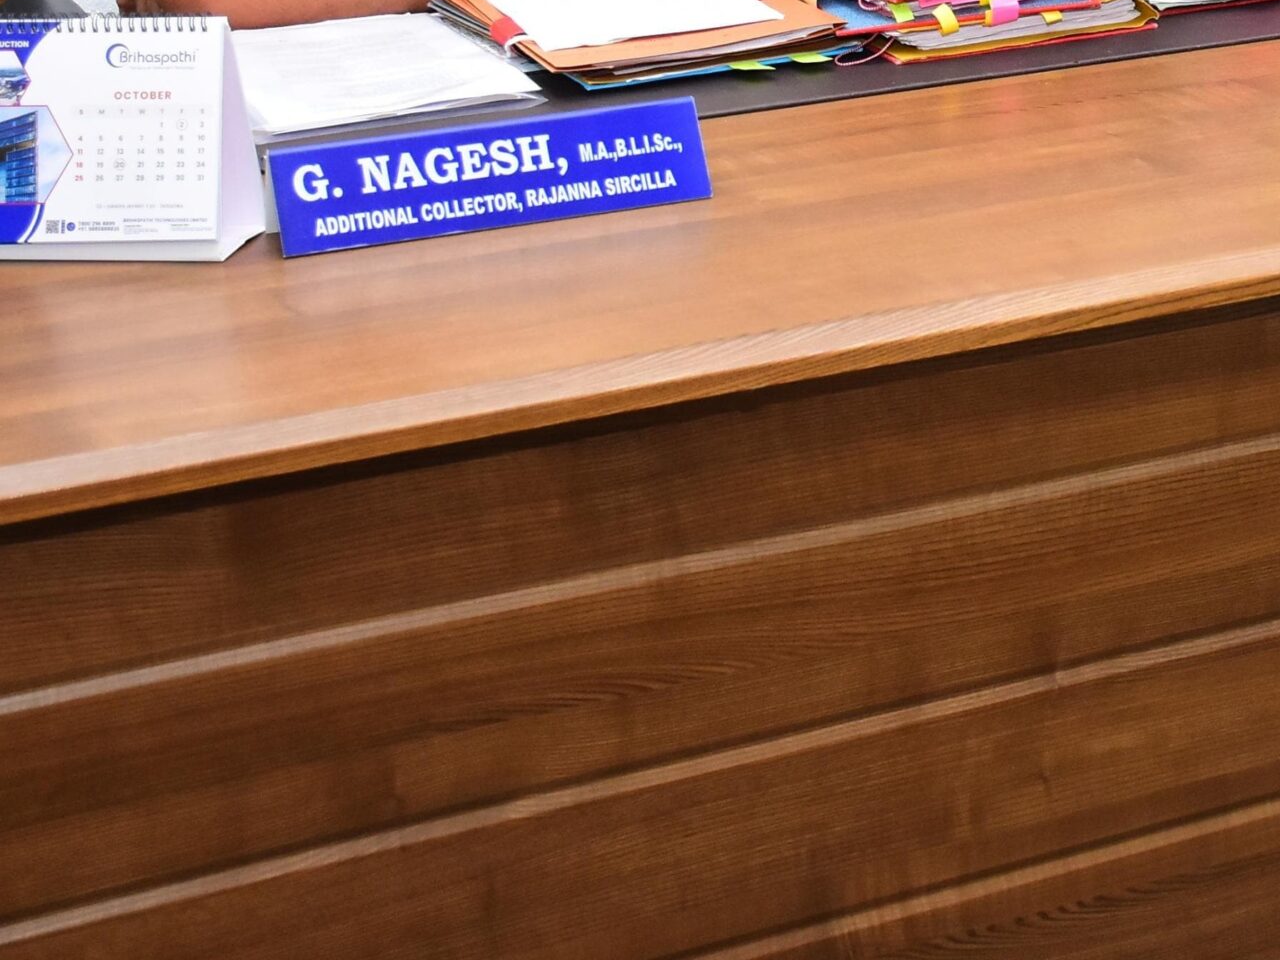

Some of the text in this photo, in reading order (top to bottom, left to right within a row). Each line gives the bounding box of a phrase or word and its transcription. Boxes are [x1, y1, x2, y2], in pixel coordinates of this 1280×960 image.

[119, 50, 197, 66] Brihaspathi
[113, 90, 173, 101] OCTOBER
[292, 133, 683, 203] G. NAGESH, M.A.,B.L.I.Sc.,
[315, 169, 677, 238] ADDITIONAL COLLECTOR, RAJANNA SIRCILLA
